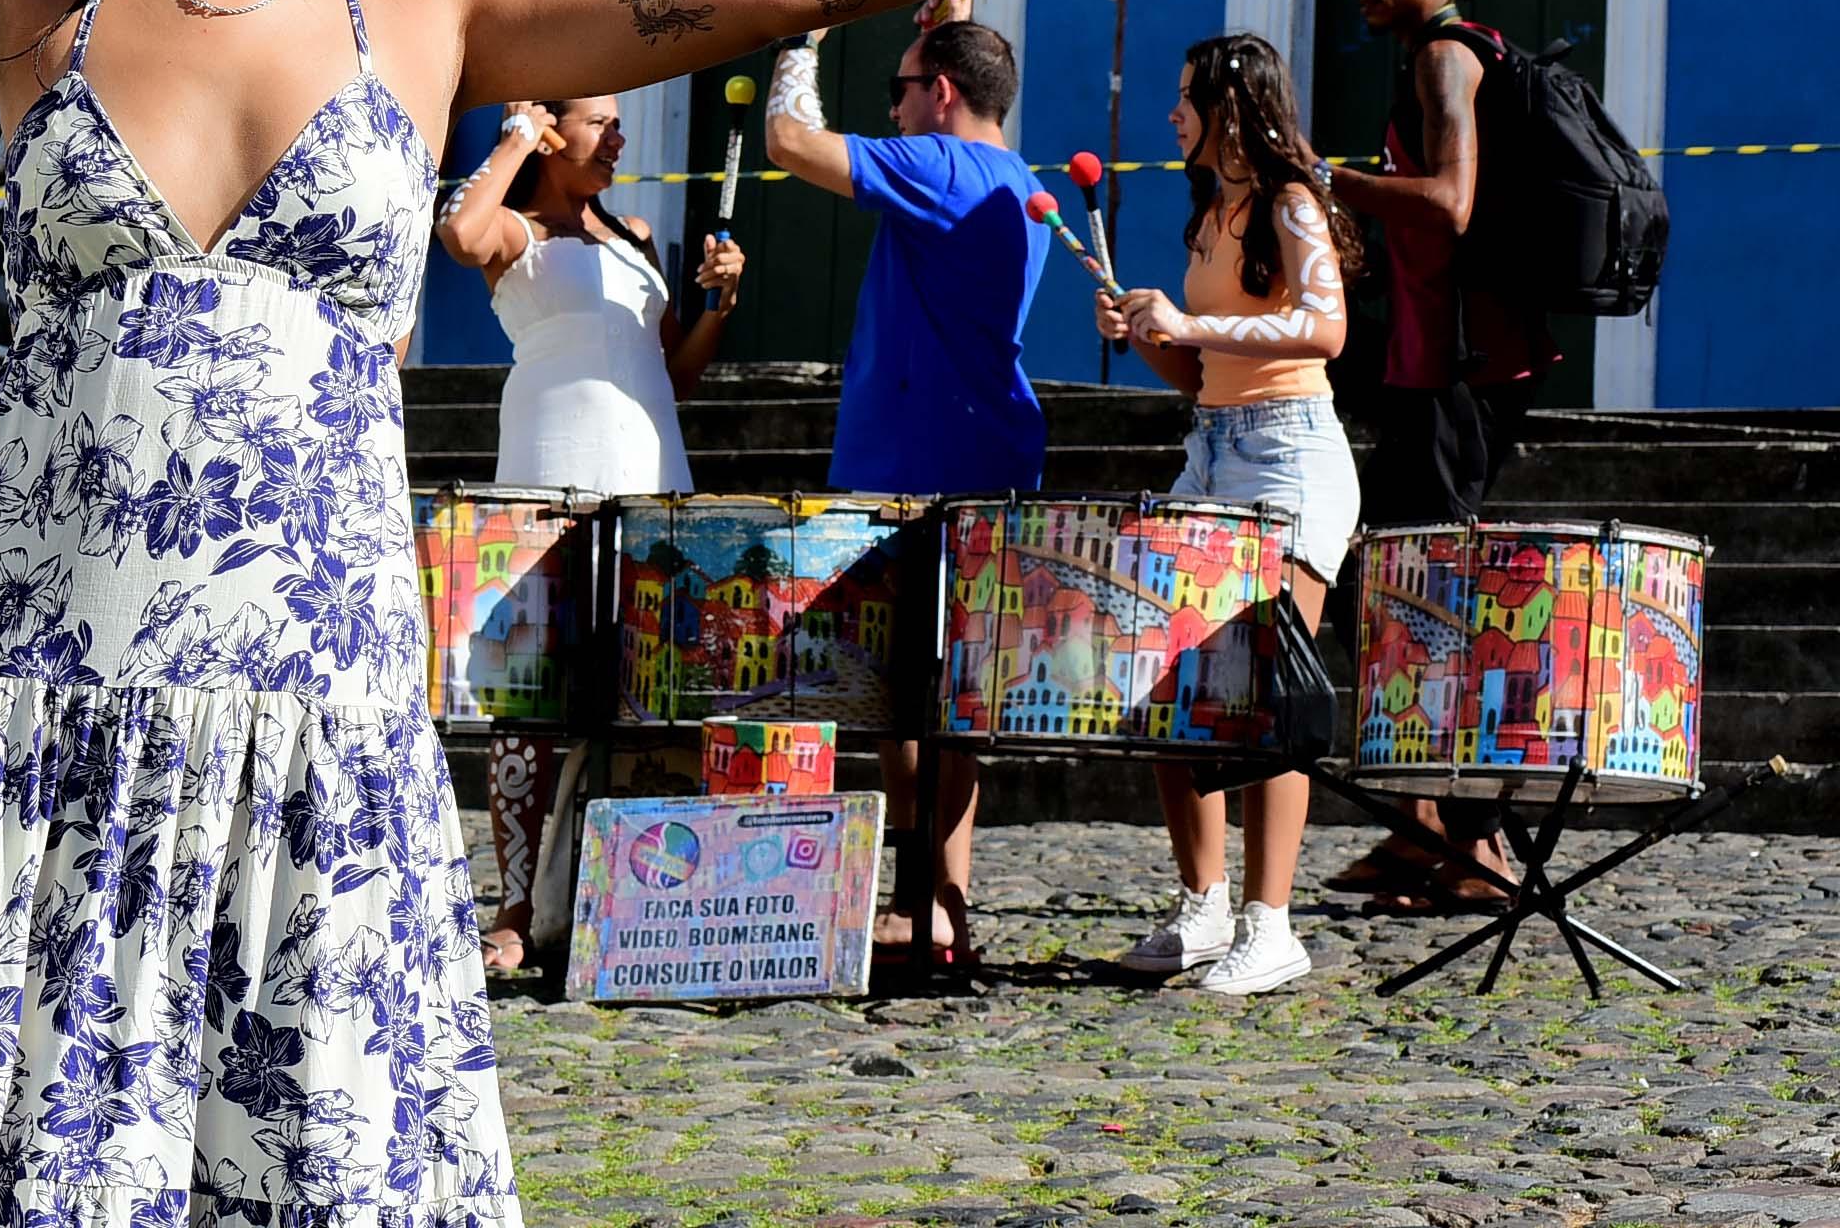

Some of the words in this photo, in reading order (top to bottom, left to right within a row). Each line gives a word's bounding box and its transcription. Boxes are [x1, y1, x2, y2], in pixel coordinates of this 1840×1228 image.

[644, 899, 694, 921] FAÇA
[699, 897, 739, 917] SUA
[613, 960, 723, 987] CONSULTE
[728, 959, 743, 981] O
[750, 956, 818, 981] VALOR
